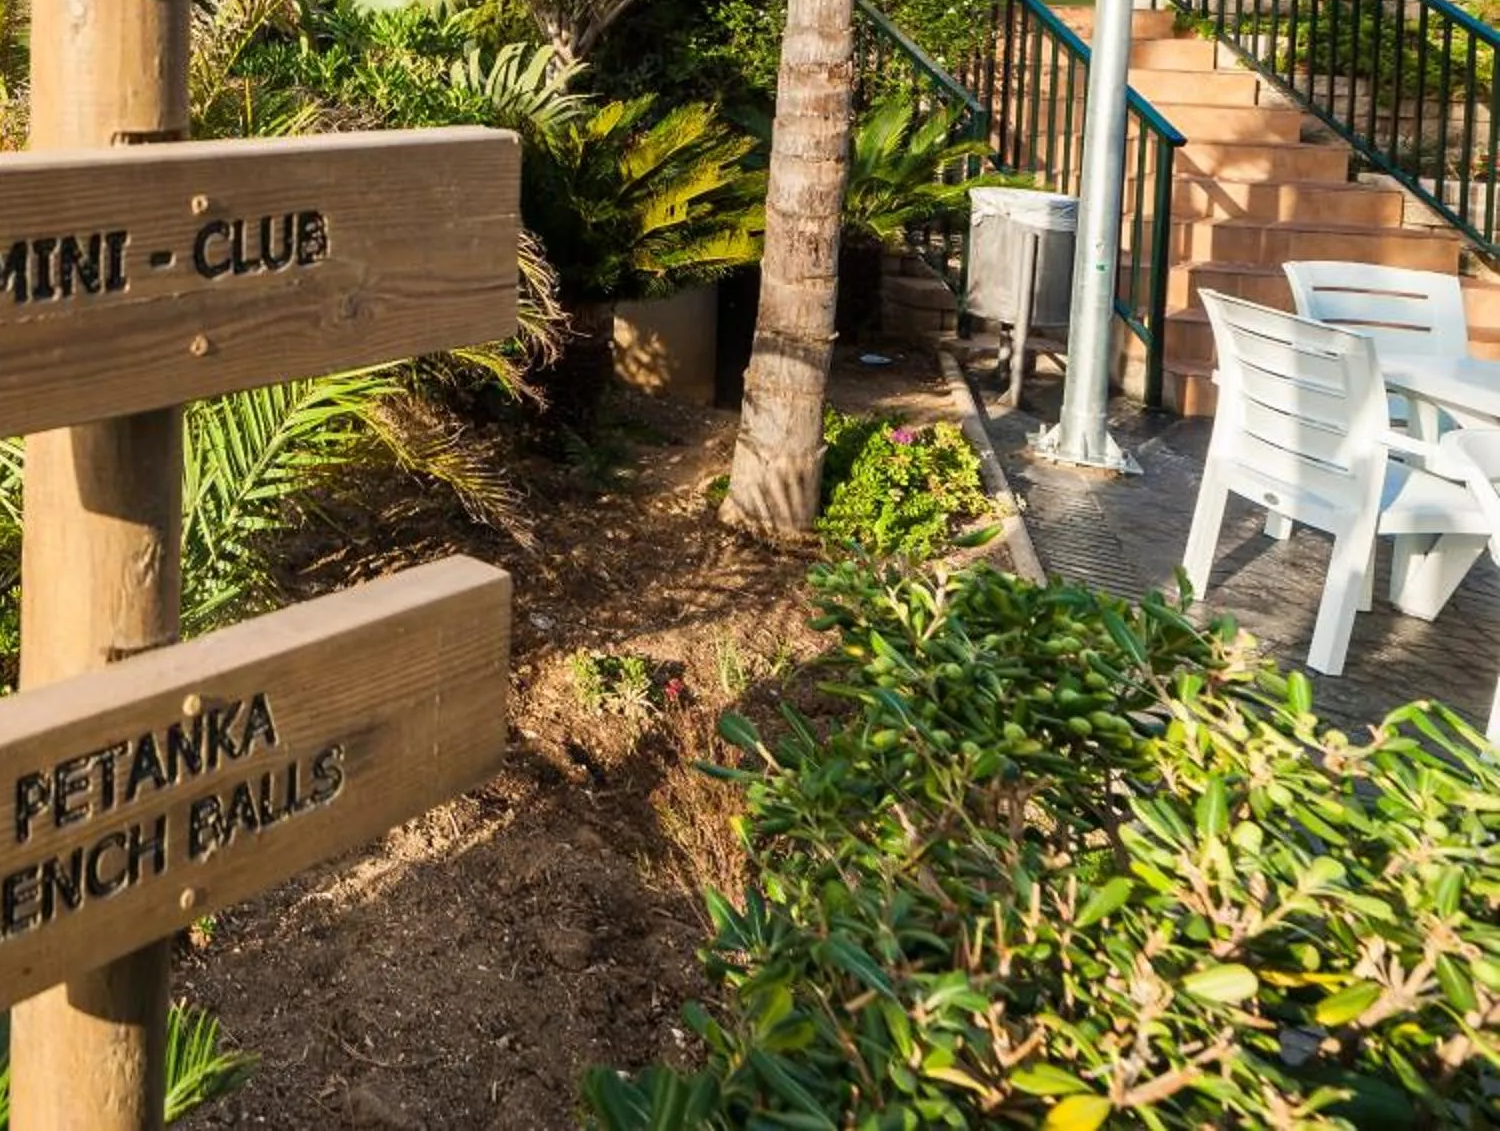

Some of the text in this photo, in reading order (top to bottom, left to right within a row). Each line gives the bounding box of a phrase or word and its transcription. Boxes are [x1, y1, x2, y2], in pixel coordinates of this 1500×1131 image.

[151, 250, 176, 268] -
[191, 210, 330, 282] CLUB
[14, 692, 279, 843] PETANKA
[188, 744, 347, 864] BALLS
